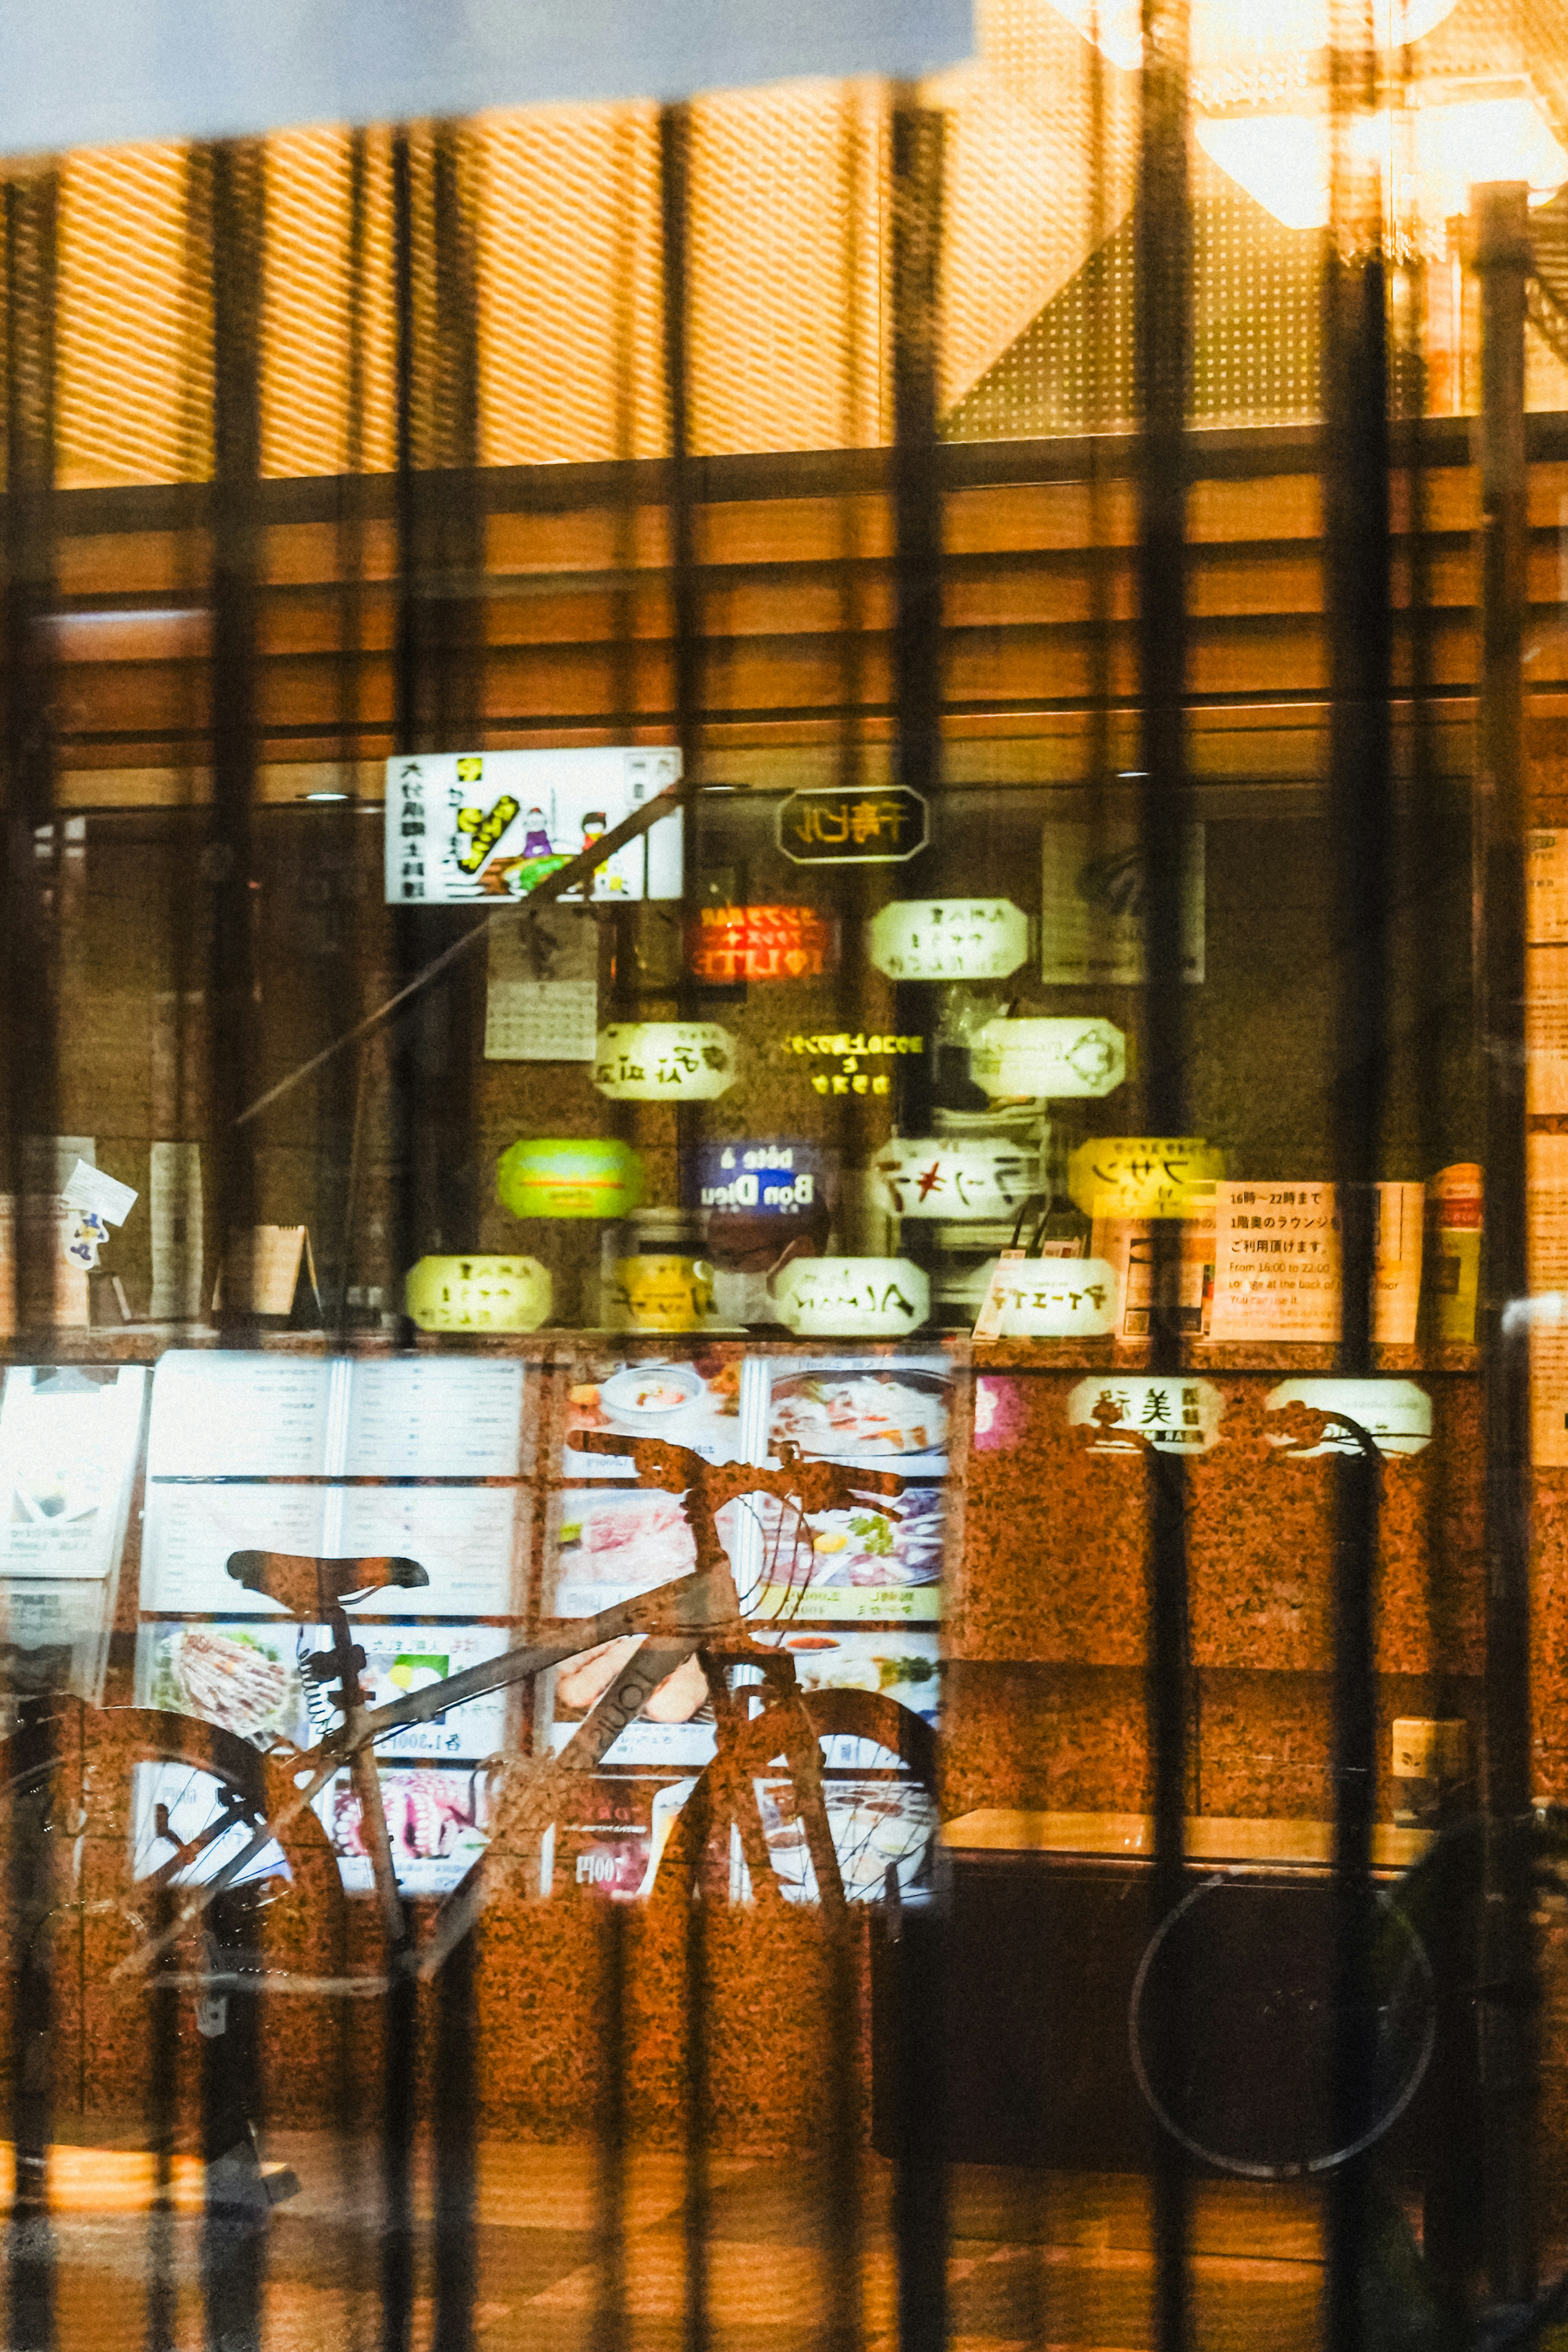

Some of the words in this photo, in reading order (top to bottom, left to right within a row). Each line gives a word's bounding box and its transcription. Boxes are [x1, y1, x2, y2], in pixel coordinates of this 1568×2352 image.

[1229, 1262, 1255, 1273] From
[1258, 1262, 1286, 1273] 16:00
[1289, 1262, 1299, 1273] to
[1267, 1279, 1277, 1289] at
[1280, 1279, 1295, 1289] the
[1298, 1279, 1321, 1289] back
[1324, 1278, 1336, 1290] of
[1231, 1294, 1248, 1304] You
